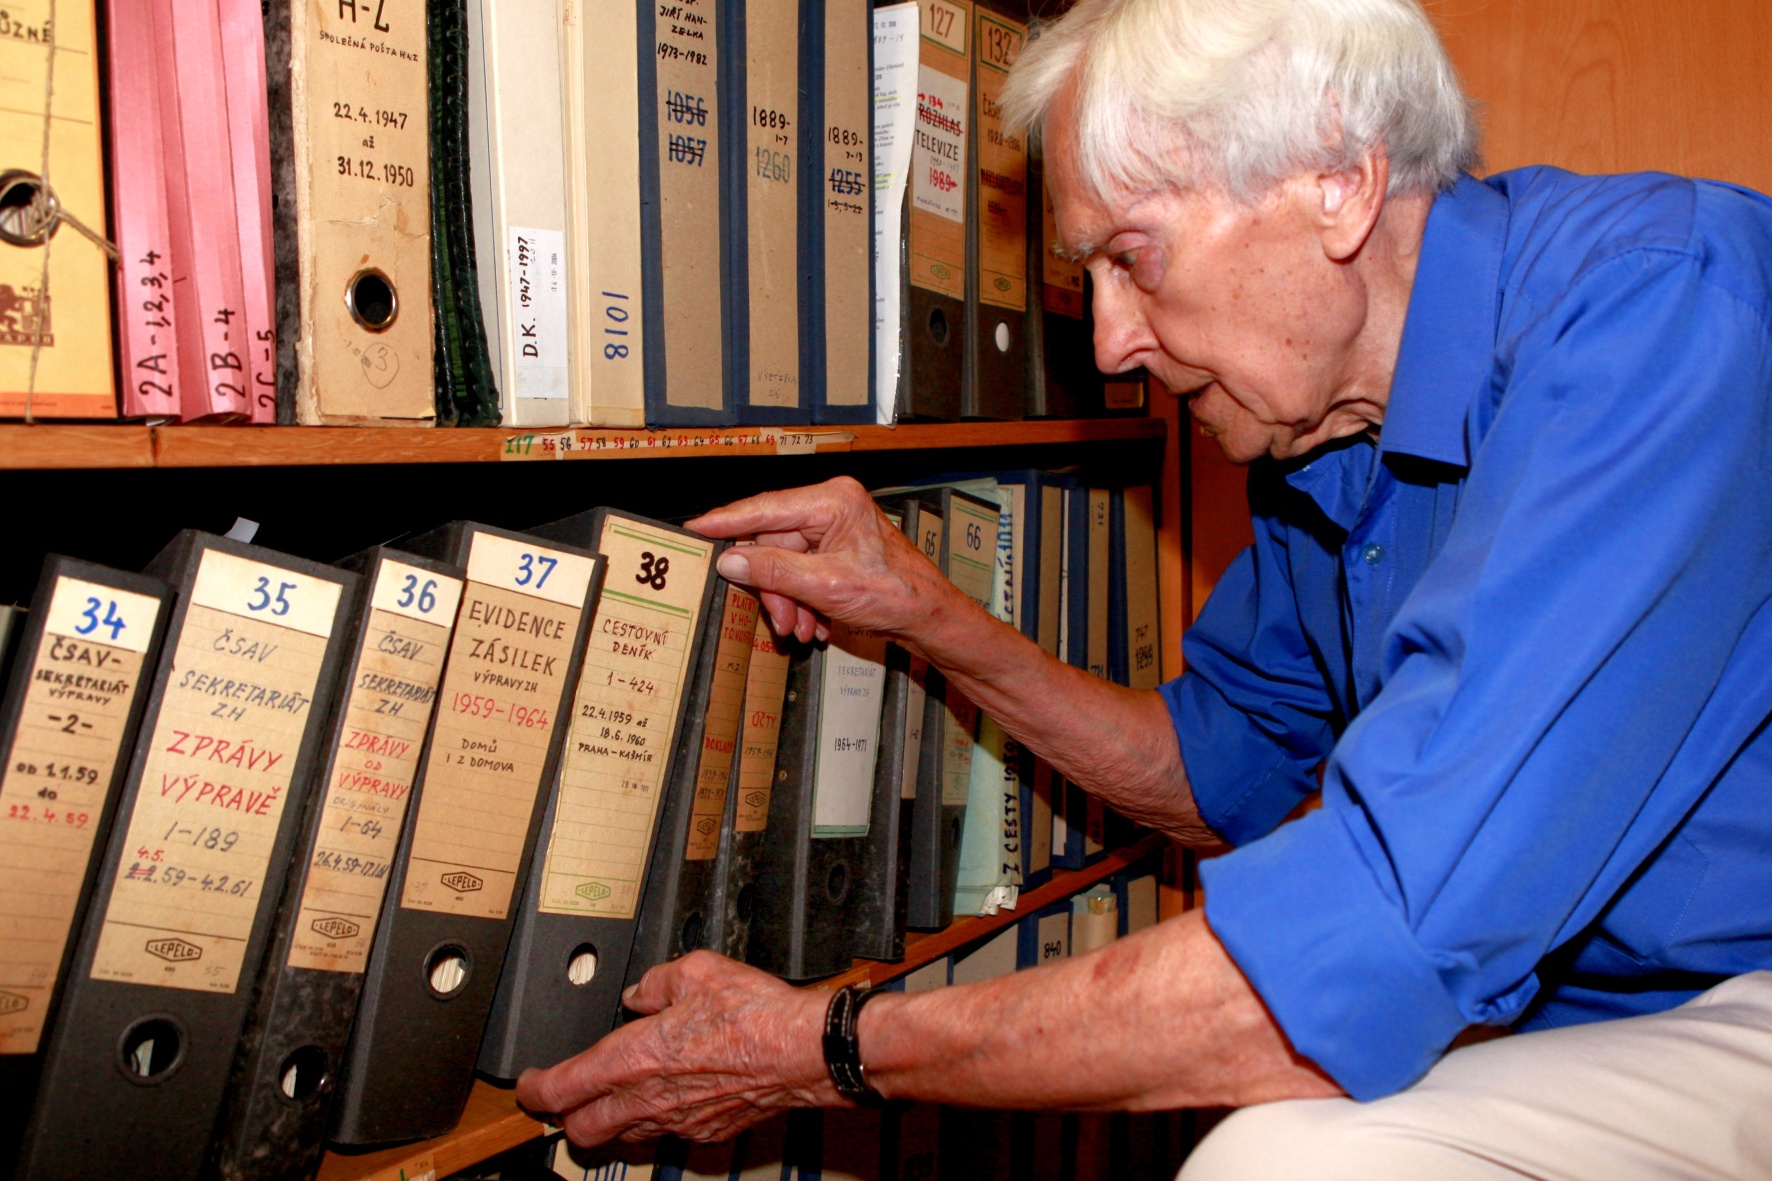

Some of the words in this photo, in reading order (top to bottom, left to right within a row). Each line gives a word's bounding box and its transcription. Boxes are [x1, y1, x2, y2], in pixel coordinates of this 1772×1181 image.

[671, 24, 704, 41] ZELKA
[928, 2, 955, 39] 127
[319, 30, 366, 50] SPOLEČNÁ
[370, 42, 397, 57] POŠTA
[657, 42, 708, 66] 1973-1982
[333, 101, 408, 131] 22.4.1947
[918, 102, 962, 137] ROZHLAS
[362, 135, 375, 149] až
[915, 129, 959, 162] TELEVIZE
[337, 155, 414, 188] 31.12.1950
[929, 167, 953, 192] 1989
[517, 236, 532, 308] 1947-1997
[602, 291, 629, 360] 8101
[542, 436, 555, 452] 55
[580, 437, 593, 453] 57
[596, 437, 607, 450] 58
[613, 436, 625, 450] 59
[629, 437, 640, 449] 60
[647, 435, 656, 448] 61
[661, 434, 672, 449] 62
[677, 434, 689, 447] 63
[693, 435, 705, 447] 64
[709, 434, 720, 446] 65
[724, 434, 734, 446] 66
[738, 434, 748, 445] 67
[751, 433, 760, 445] 68
[765, 434, 775, 446] 69
[779, 435, 788, 446] 71
[791, 434, 801, 446] 72
[804, 434, 814, 445] 73
[925, 530, 937, 557] 65
[966, 522, 982, 552] 66
[514, 553, 558, 589] 37
[635, 551, 670, 591] 38
[247, 576, 298, 617] 35
[396, 574, 438, 614] 36
[74, 596, 127, 640] 34
[469, 600, 566, 640] EVIDENCE
[602, 618, 669, 646] CESTOVNÍ
[212, 627, 279, 662] ČSAV
[377, 630, 424, 660] ČSAV
[469, 637, 557, 677] ZÁSILEK
[612, 641, 656, 661] DENÍK
[35, 667, 130, 695] SEKRETARIÁT
[48, 685, 111, 707] VÝPRAVY
[179, 669, 311, 715] SEKRETARIÁT
[358, 673, 437, 704] SEKRETARIÁT
[473, 670, 524, 692] VÝPRAVY
[211, 702, 247, 722] ZH
[374, 699, 404, 716] ZH
[452, 692, 549, 730] 1959-1964
[581, 704, 632, 726] 22.4.1959
[636, 718, 649, 728] až
[752, 711, 777, 728] ÚČTY
[166, 730, 283, 773] ZPRÁVY
[344, 731, 410, 759] ZPRÁVY
[461, 738, 498, 753] DOMŮ
[364, 760, 382, 771] OD
[469, 756, 515, 773] DOMOVA
[161, 773, 282, 816] VÝPRAVĚ
[338, 771, 409, 800] VÝPRAVY
[1003, 792, 1019, 853] CESTY
[1043, 940, 1062, 959] 840
